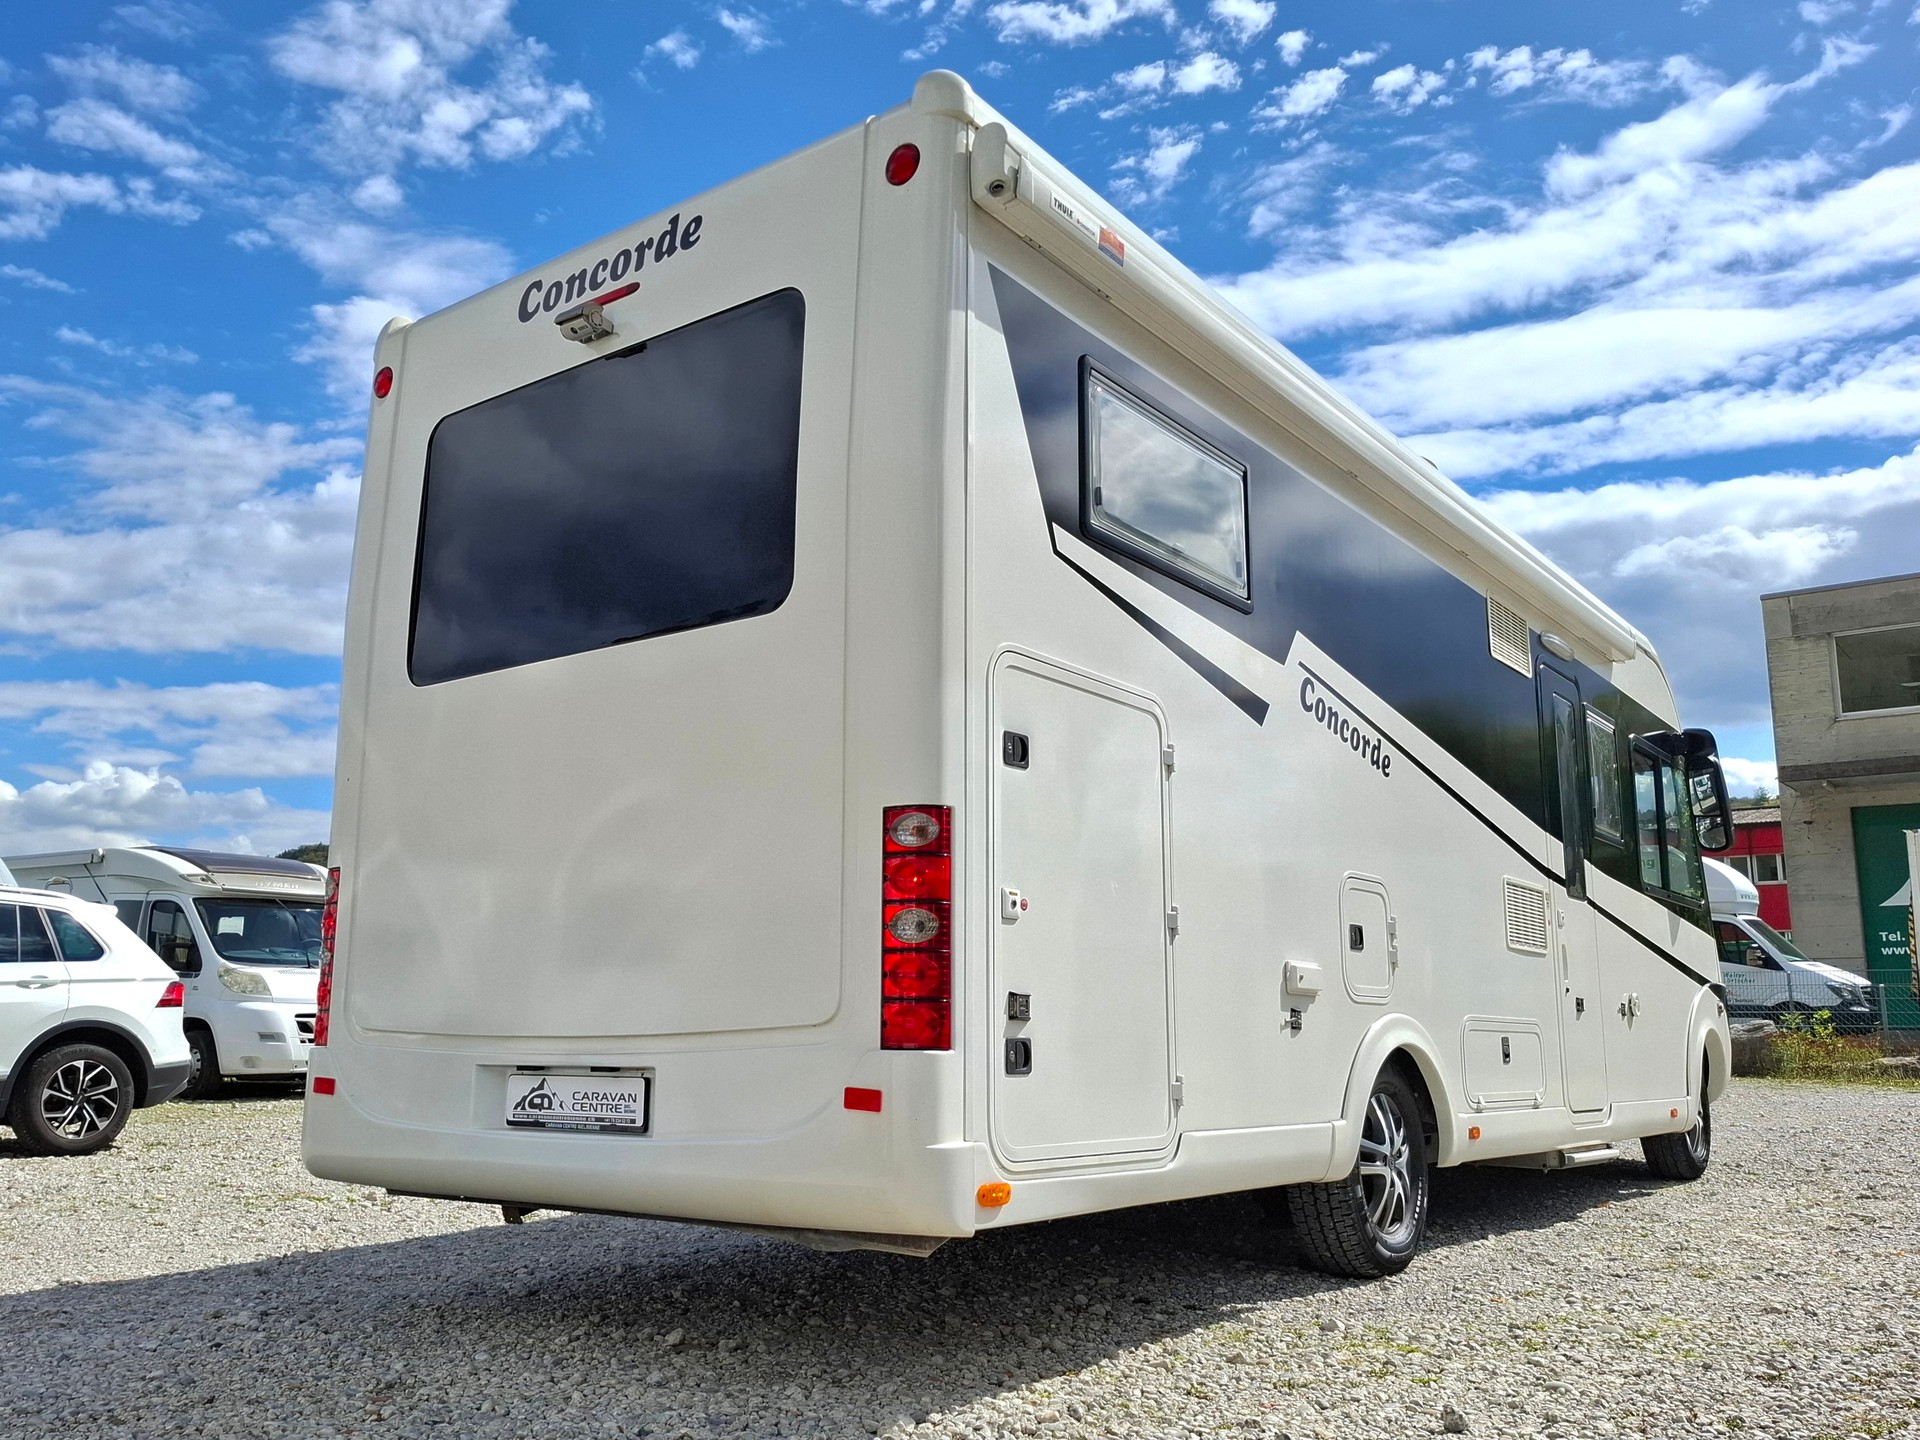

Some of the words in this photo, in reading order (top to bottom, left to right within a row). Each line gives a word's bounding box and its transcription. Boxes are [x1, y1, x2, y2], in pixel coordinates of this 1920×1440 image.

[1053, 197, 1074, 220] THULE
[518, 213, 703, 323] Concorde
[1300, 676, 1391, 778] Concorde
[1879, 931, 1906, 942] Tel.
[572, 1091, 637, 1103] CARAVAN
[572, 1102, 623, 1114] CENTRE
